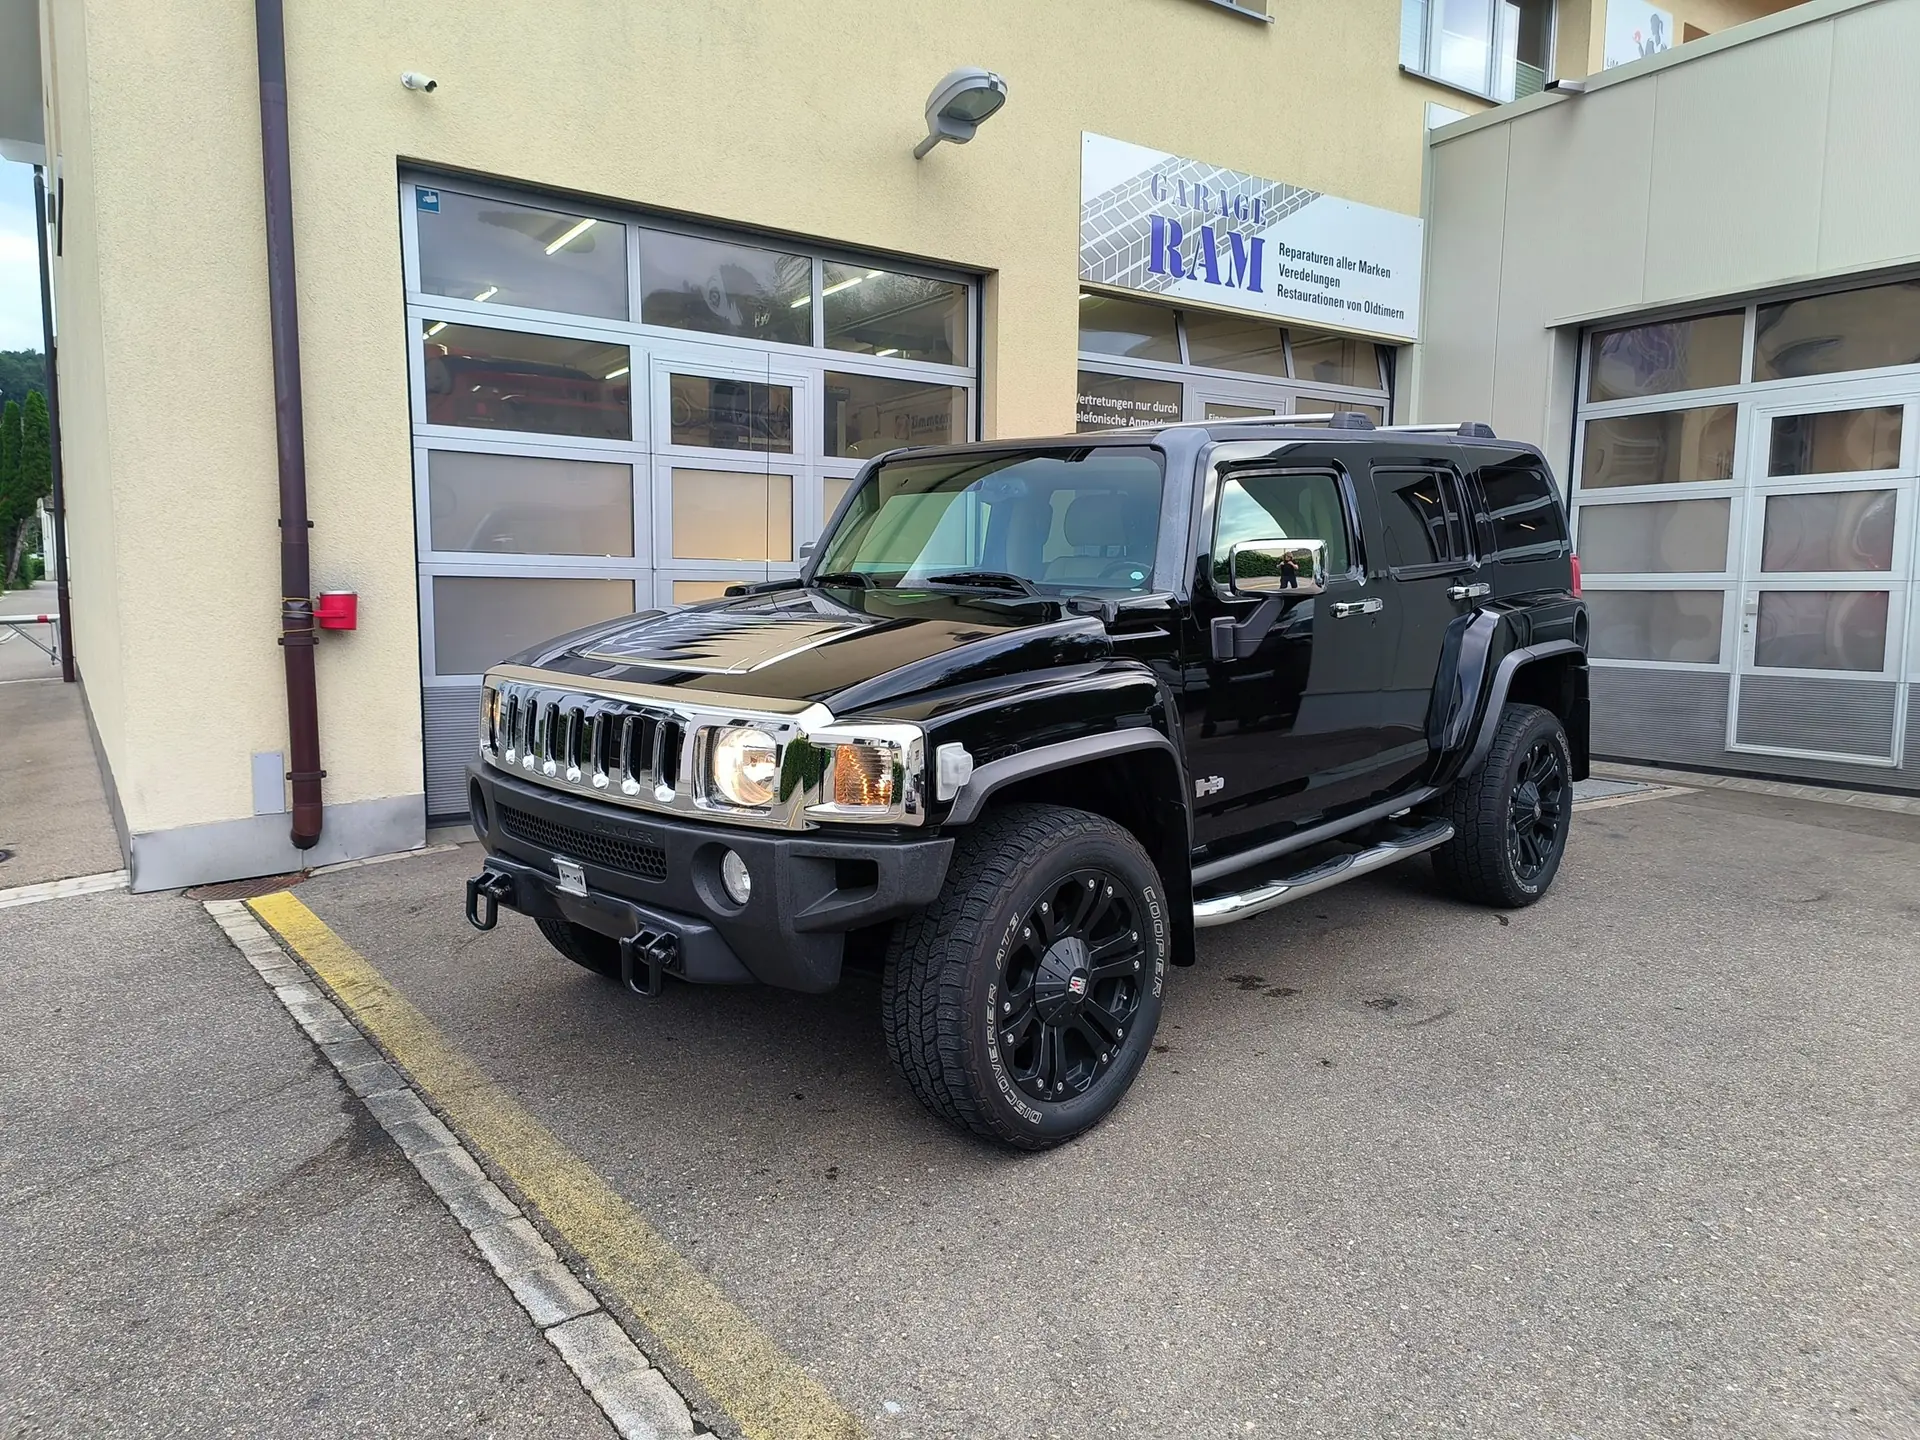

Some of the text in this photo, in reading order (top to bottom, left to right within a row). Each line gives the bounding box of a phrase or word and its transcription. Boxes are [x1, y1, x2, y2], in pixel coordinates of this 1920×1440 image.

[1150, 173, 1267, 226] GARAGE
[1147, 213, 1266, 293] RAM
[1278, 242, 1391, 279] Reparaturen aller Marken
[1278, 262, 1341, 289] Veredelungen
[1277, 283, 1405, 320] Restaurationen von Oldtimern
[1076, 411, 1127, 427] elefonische
[1135, 402, 1152, 412] nur
[1152, 401, 1178, 414] durch
[1195, 776, 1225, 798] H3
[1143, 886, 1165, 998] COOPER
[986, 912, 1043, 1125] DISCOVERER AT3
